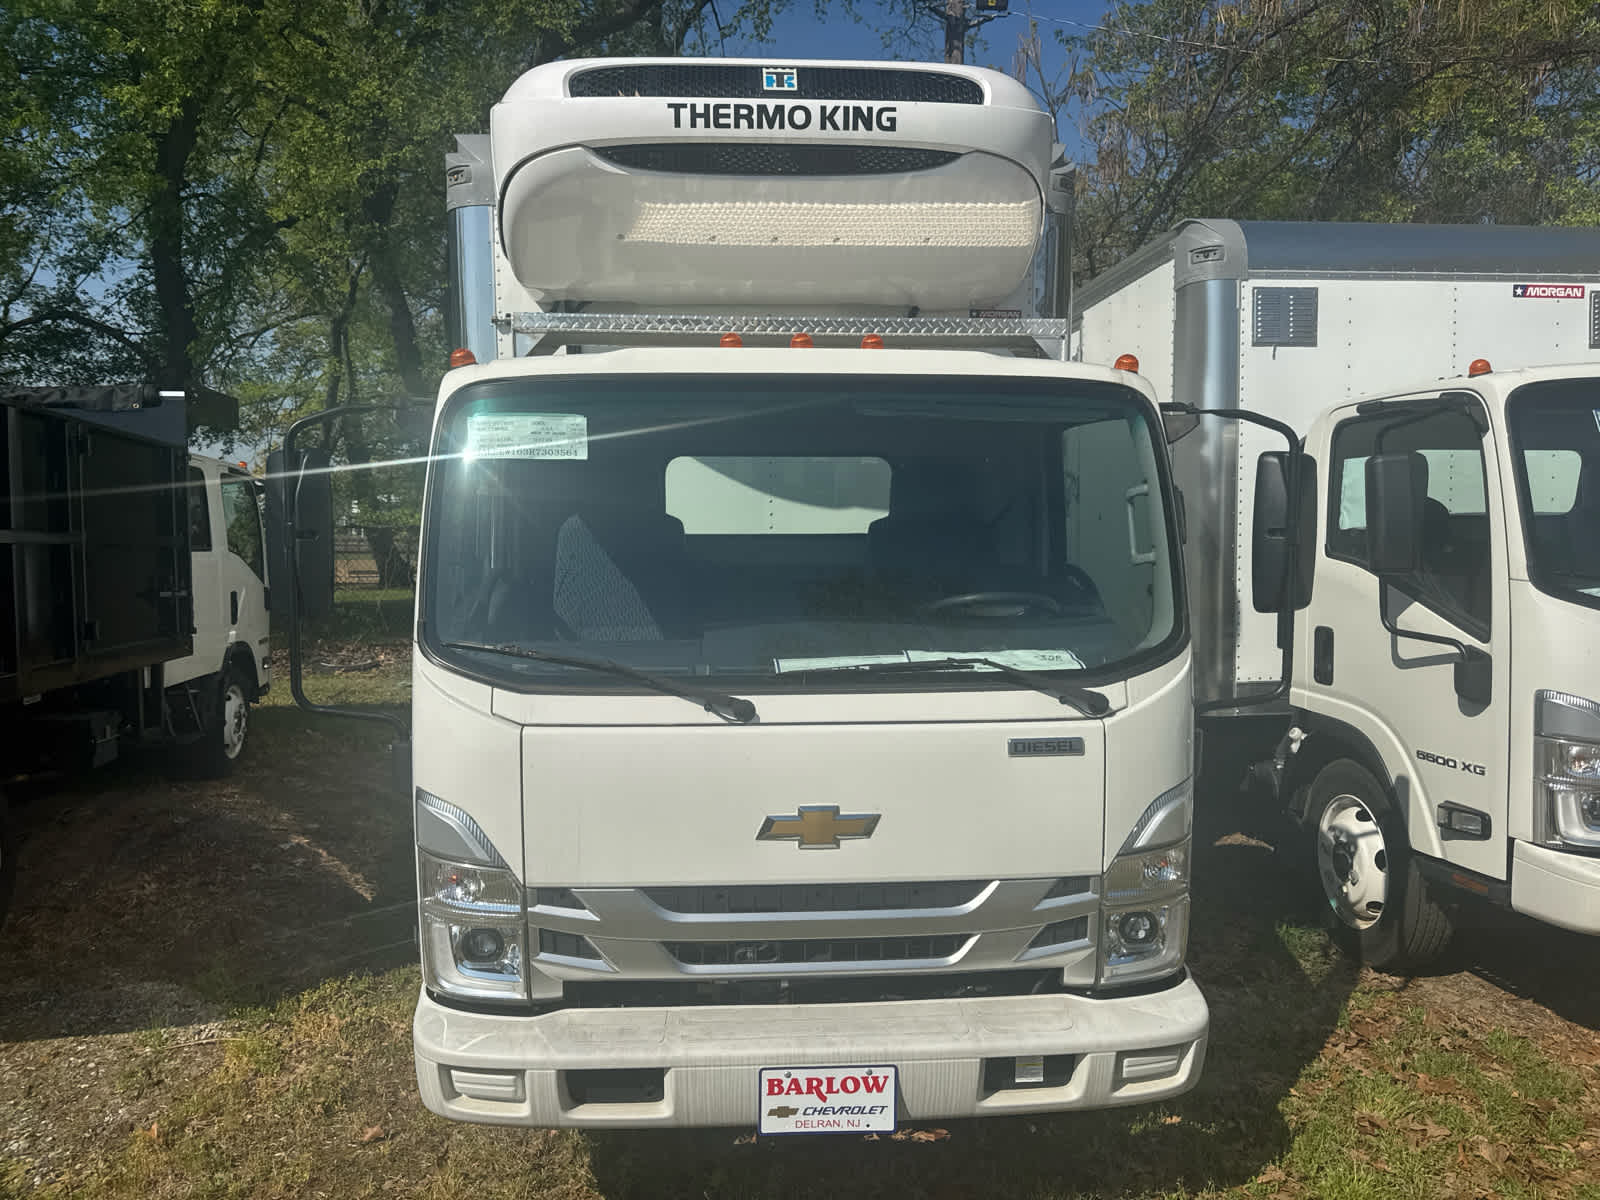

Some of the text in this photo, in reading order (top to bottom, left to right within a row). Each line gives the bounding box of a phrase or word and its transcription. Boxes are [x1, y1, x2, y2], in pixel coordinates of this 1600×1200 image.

[667, 103, 896, 132] THERMO KING
[1526, 286, 1582, 297] MORGAN
[1014, 741, 1081, 753] DIESEL
[1461, 761, 1486, 776] XG
[767, 1075, 889, 1103] BARLOW
[802, 1105, 888, 1116] CHEVROLET
[795, 1119, 861, 1129] DELRAN, NJ
